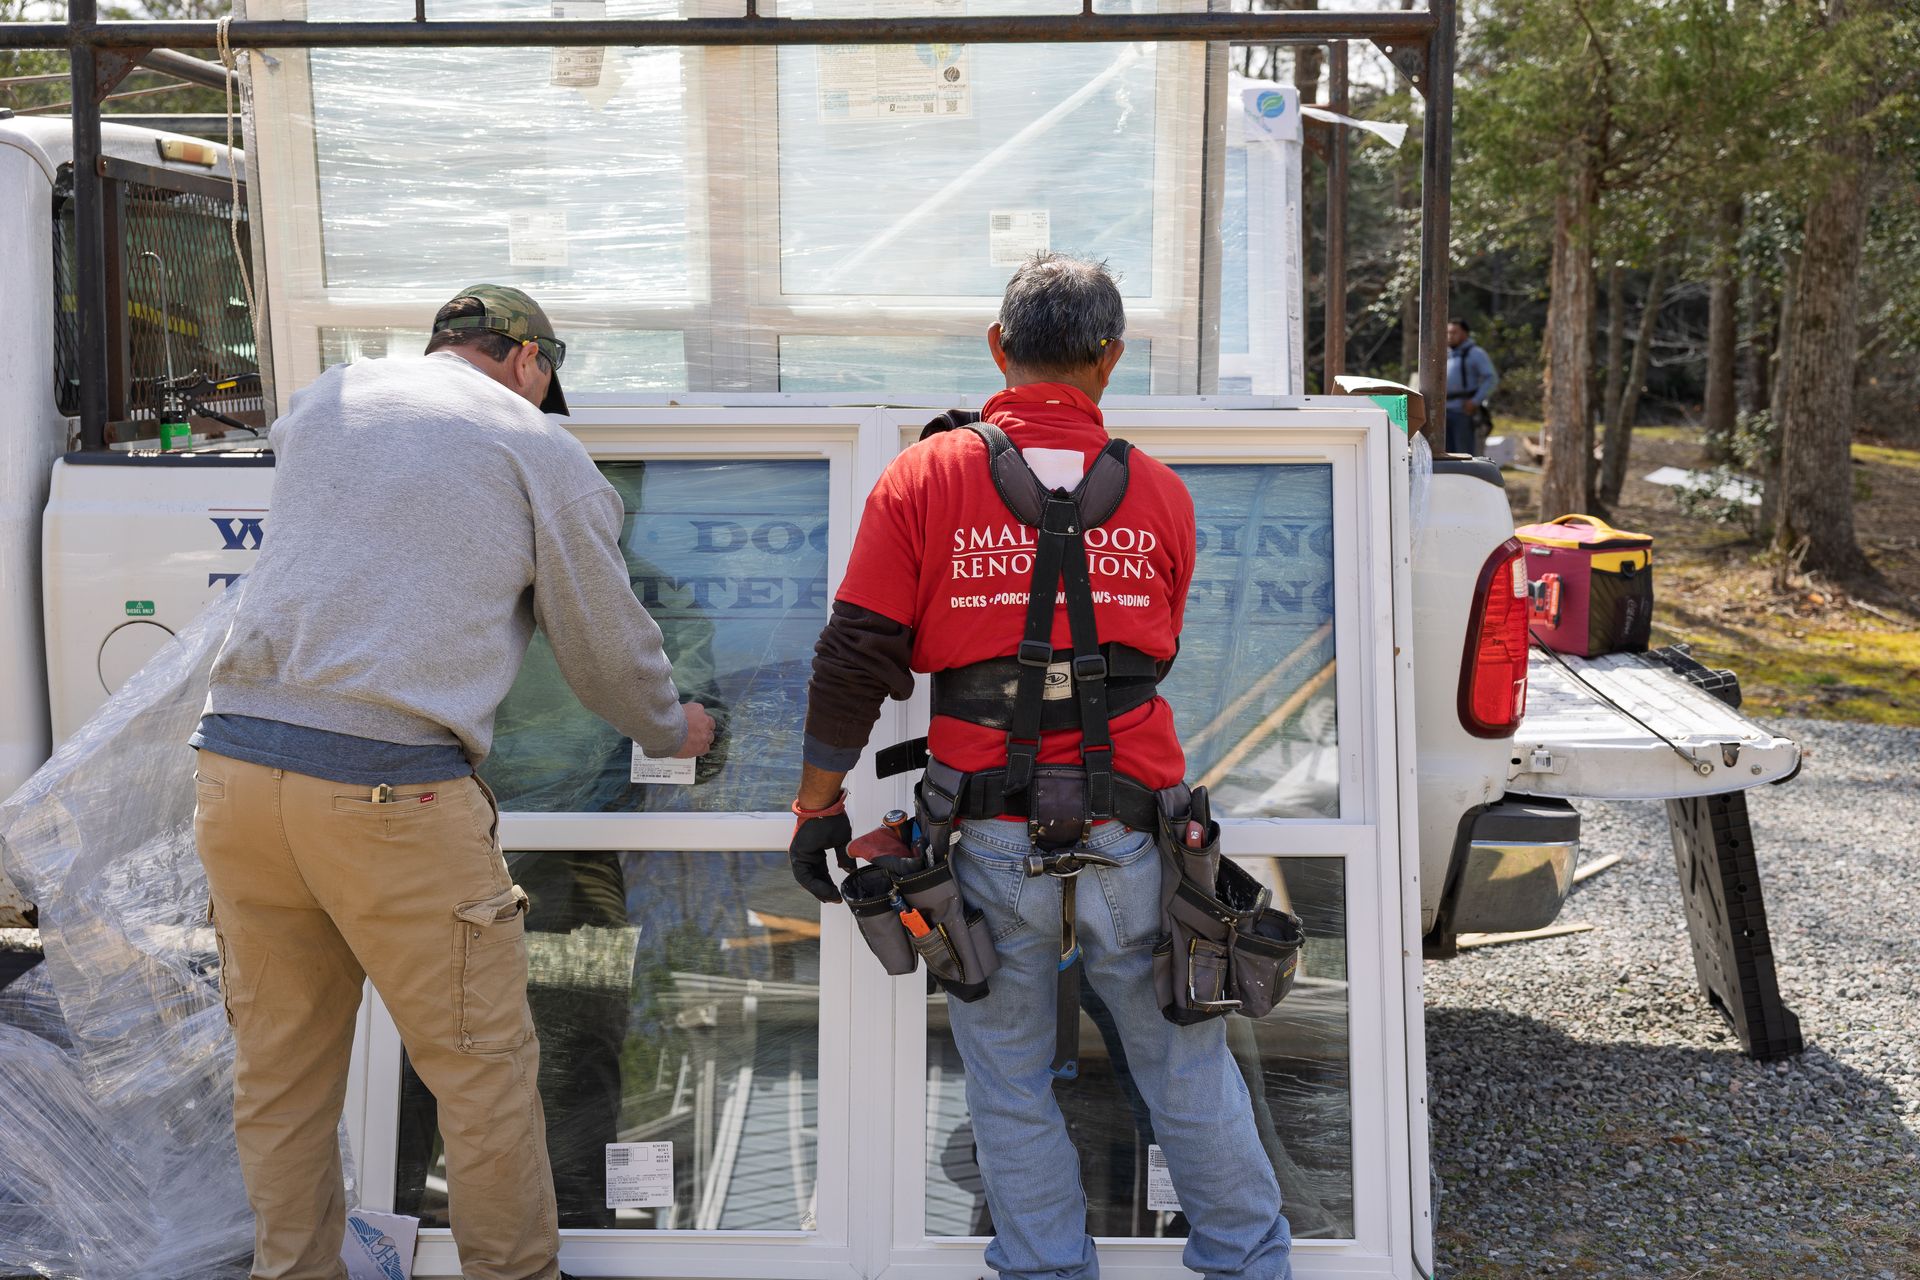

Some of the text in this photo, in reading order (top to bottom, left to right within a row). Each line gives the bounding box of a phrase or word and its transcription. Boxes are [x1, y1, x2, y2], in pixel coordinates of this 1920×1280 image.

[953, 524, 1156, 553] SMALOOD
[952, 553, 1155, 580] RENOIONS
[951, 594, 987, 608] DECKS
[994, 592, 1031, 605] PORCH
[1117, 594, 1150, 607] SIDING
